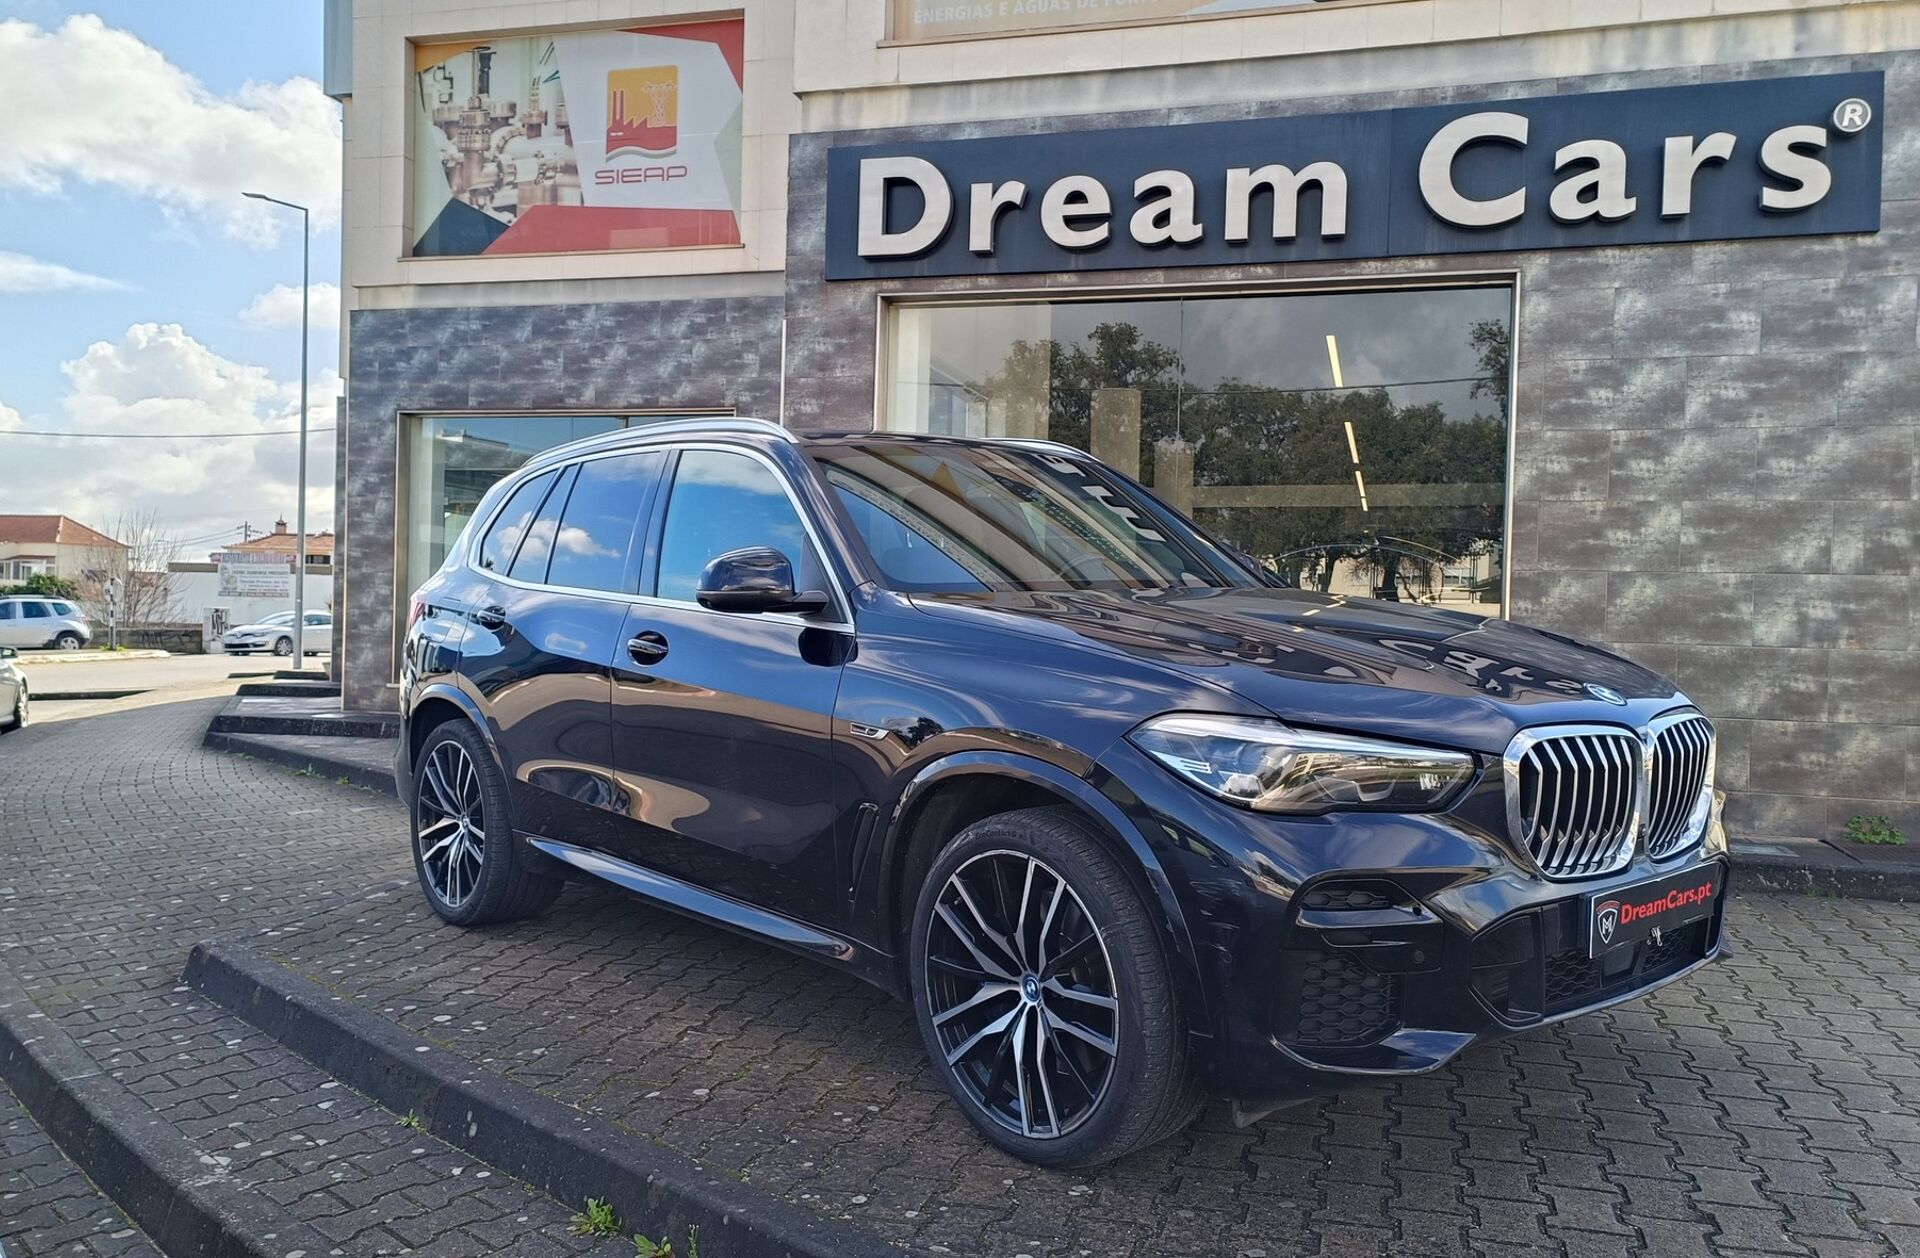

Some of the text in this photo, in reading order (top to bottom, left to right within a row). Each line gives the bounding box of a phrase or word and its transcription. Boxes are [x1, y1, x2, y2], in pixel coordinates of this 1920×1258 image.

[914, 4, 993, 24] ENERGIAS
[999, 2, 1008, 16] E
[594, 165, 688, 186] SIEAP
[857, 156, 1349, 261] Dream
[1620, 881, 1713, 925] DreamCars.pt
